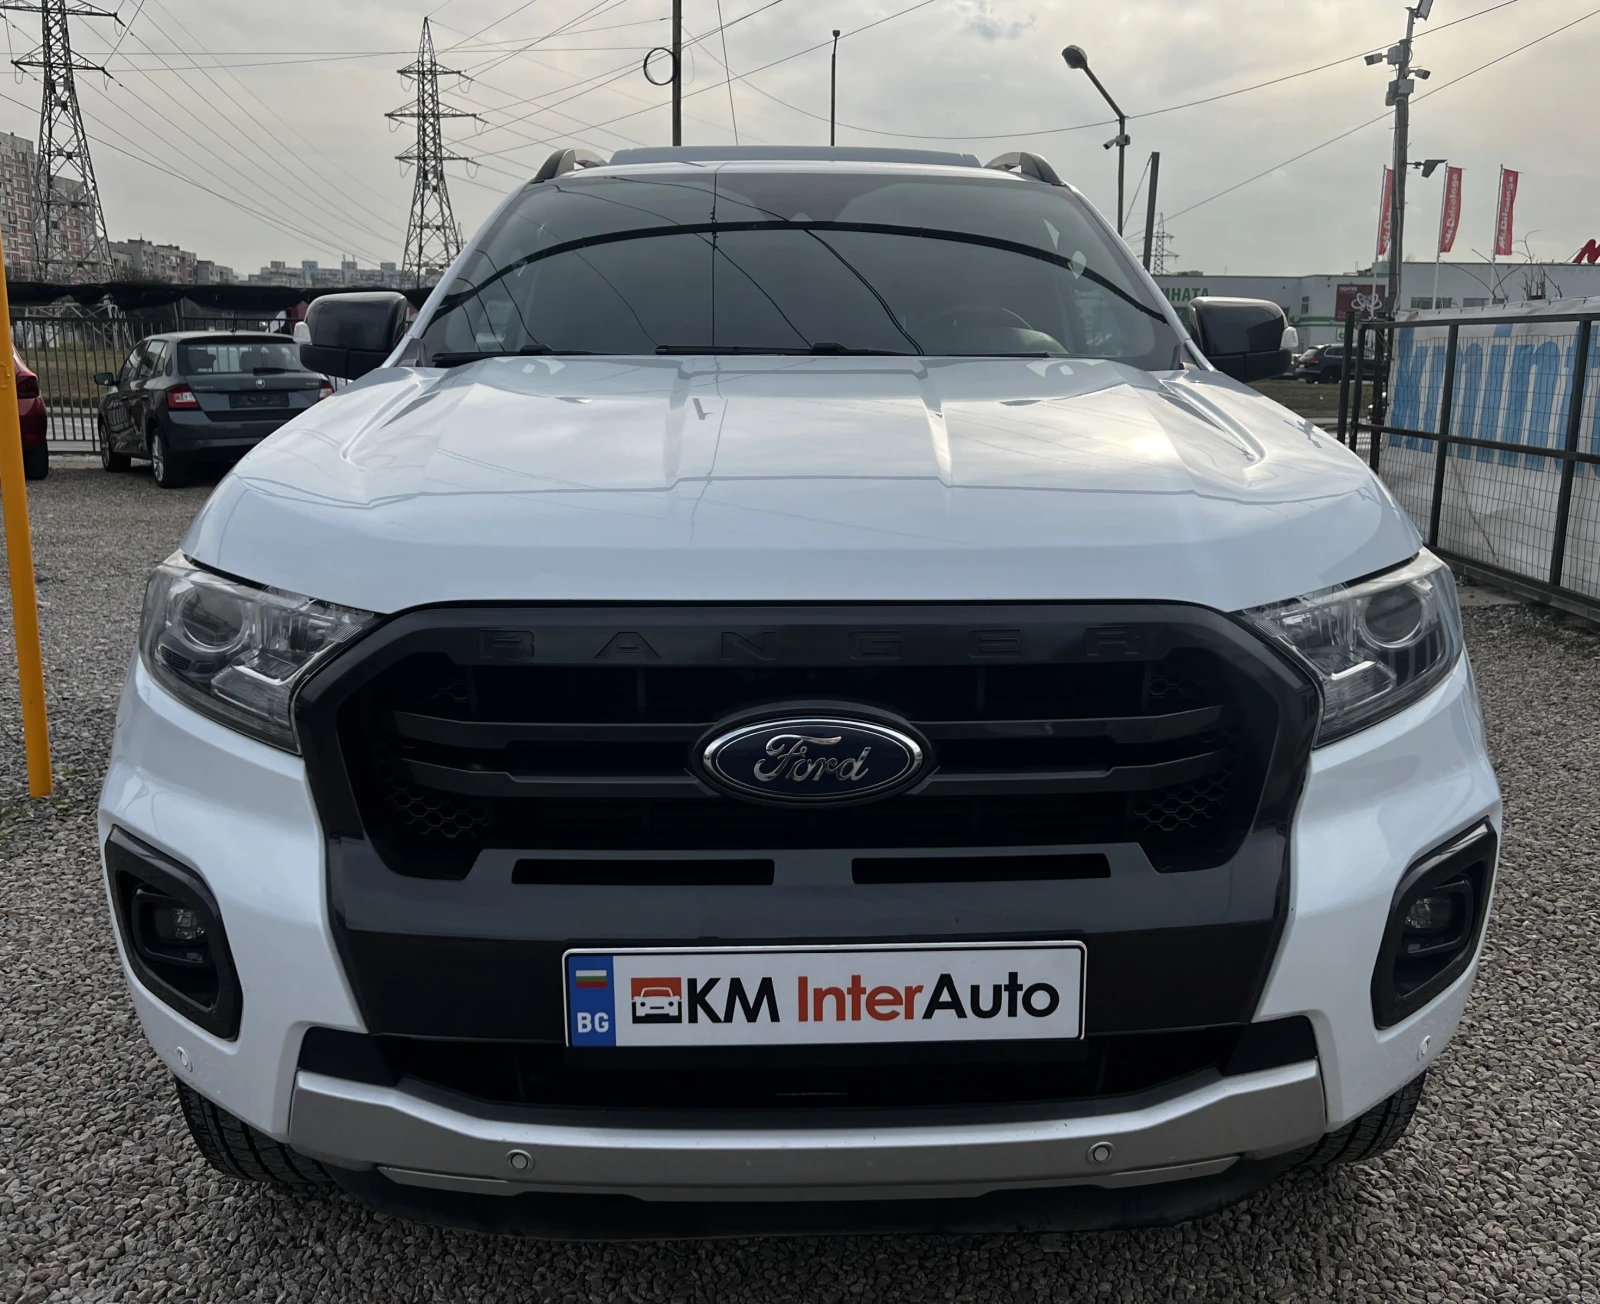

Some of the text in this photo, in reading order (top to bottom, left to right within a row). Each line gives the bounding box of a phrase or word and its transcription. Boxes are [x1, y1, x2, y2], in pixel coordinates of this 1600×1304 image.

[479, 626, 1139, 660] RANGER
[753, 734, 872, 782] Ford
[687, 971, 1060, 1024] KM InterAuto
[577, 1012, 609, 1033] BG
